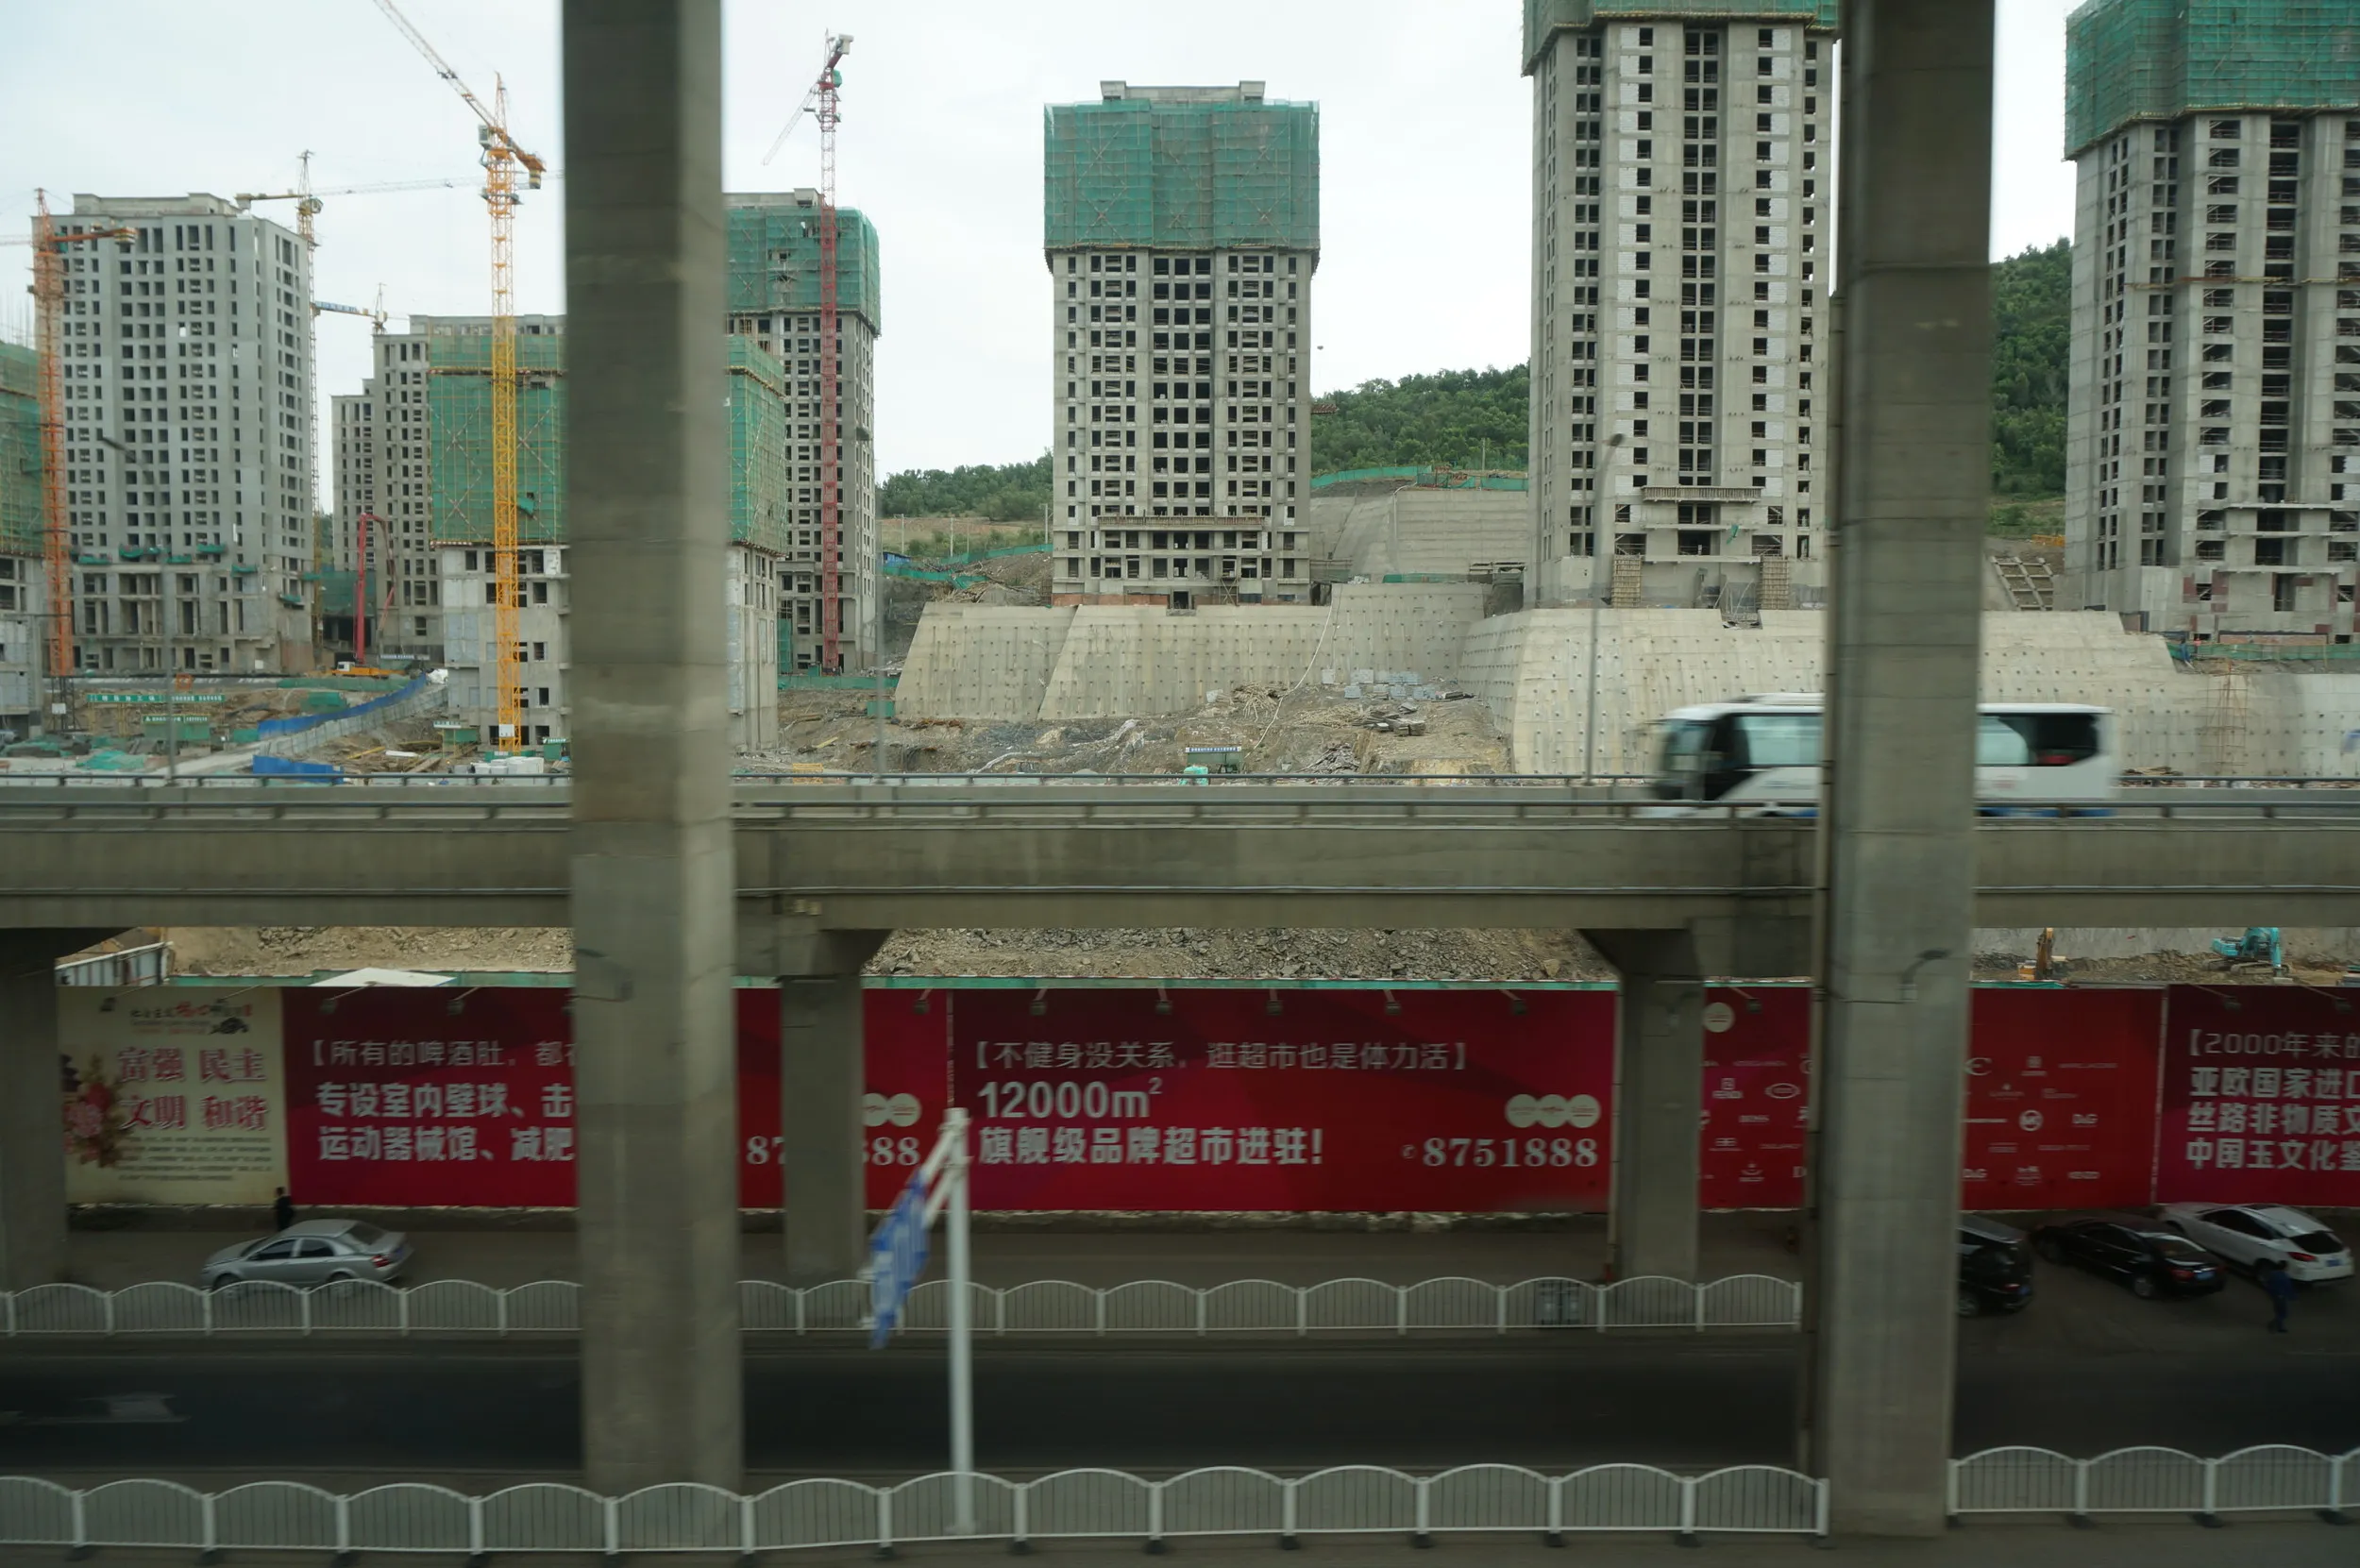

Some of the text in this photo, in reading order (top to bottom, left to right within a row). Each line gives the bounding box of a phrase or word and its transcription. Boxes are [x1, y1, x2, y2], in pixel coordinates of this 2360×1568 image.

[199, 1048, 267, 1083] 民主
[118, 1094, 268, 1131] 文明 和谐
[1422, 1137, 1599, 1168] 8751888
